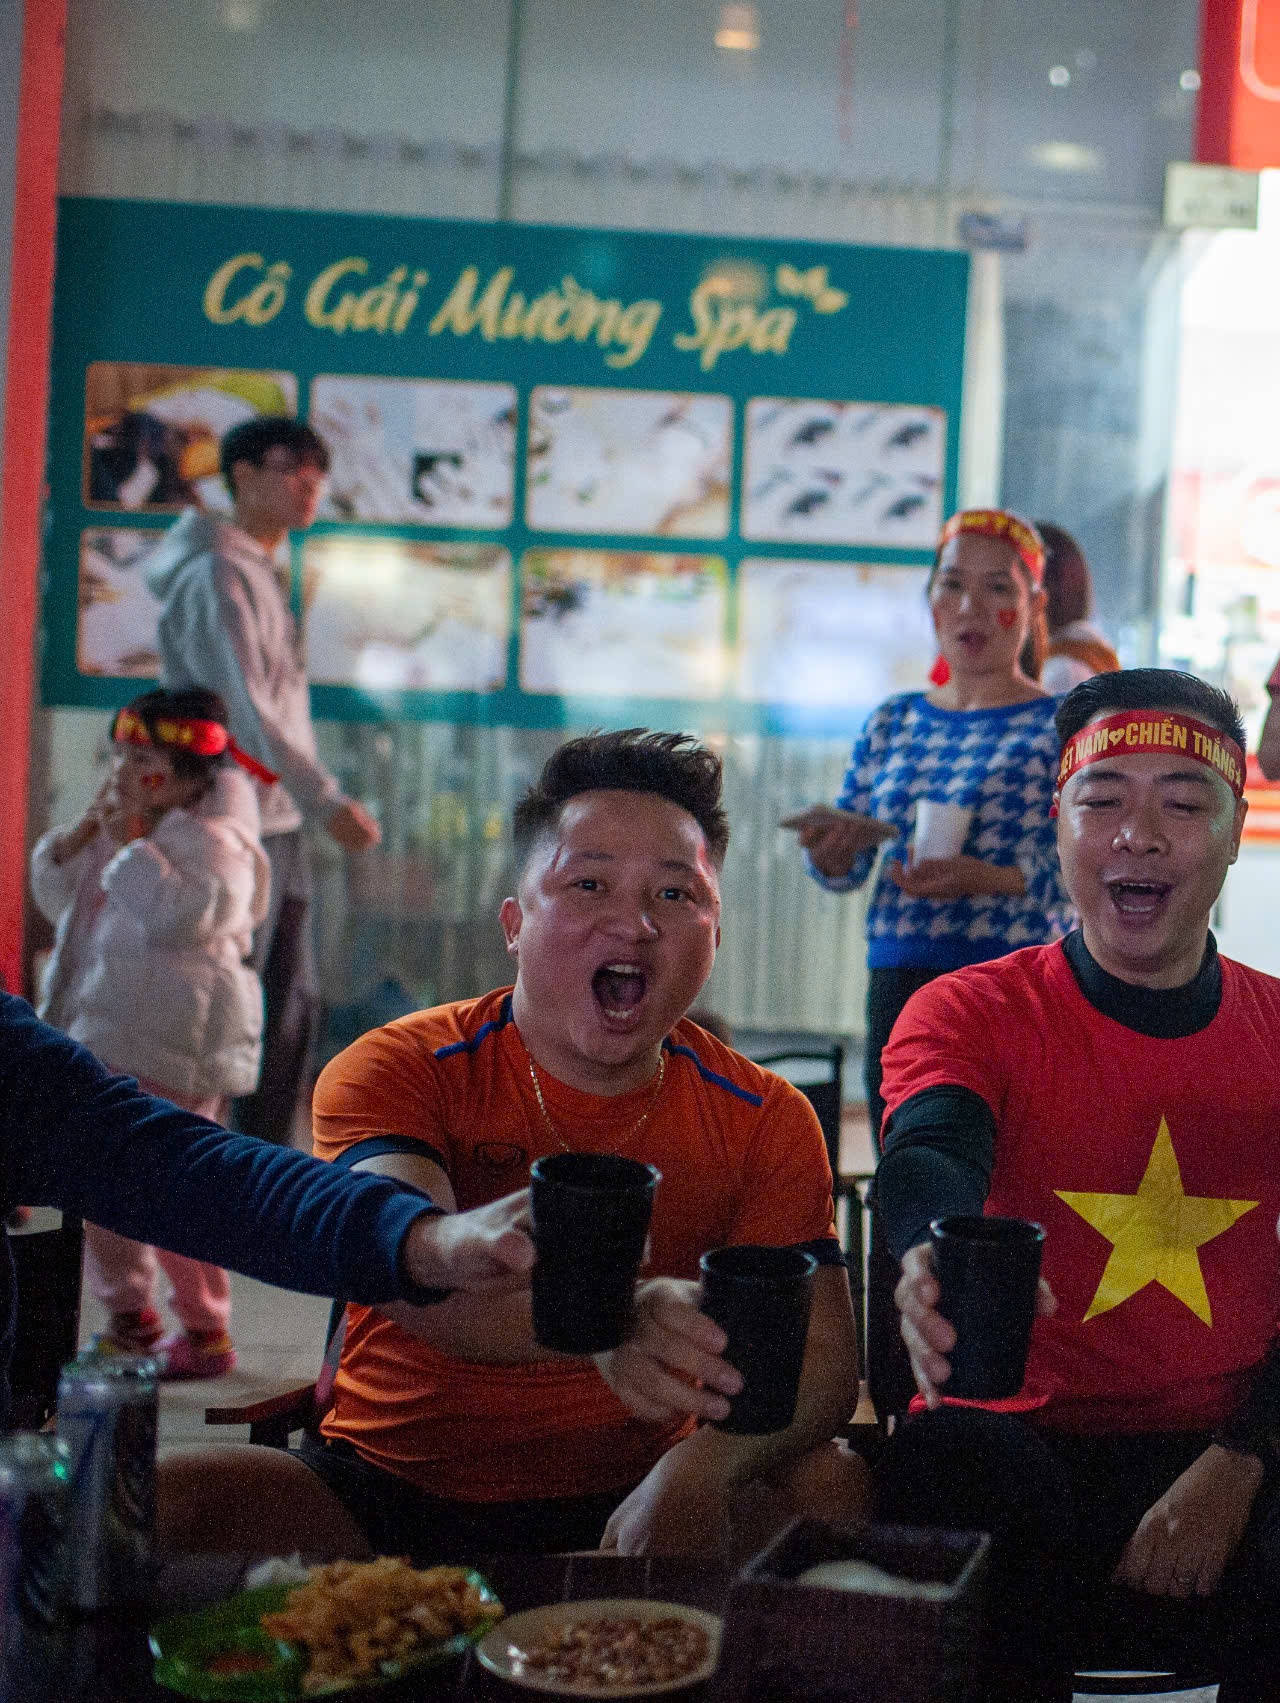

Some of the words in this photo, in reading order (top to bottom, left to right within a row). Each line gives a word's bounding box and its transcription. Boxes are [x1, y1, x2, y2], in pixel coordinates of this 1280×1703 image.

[203, 252, 294, 328] Cô
[303, 255, 430, 337] Gái
[673, 274, 798, 371] Spa
[1075, 727, 1109, 764] NAM
[1125, 716, 1188, 750] CHIẾN
